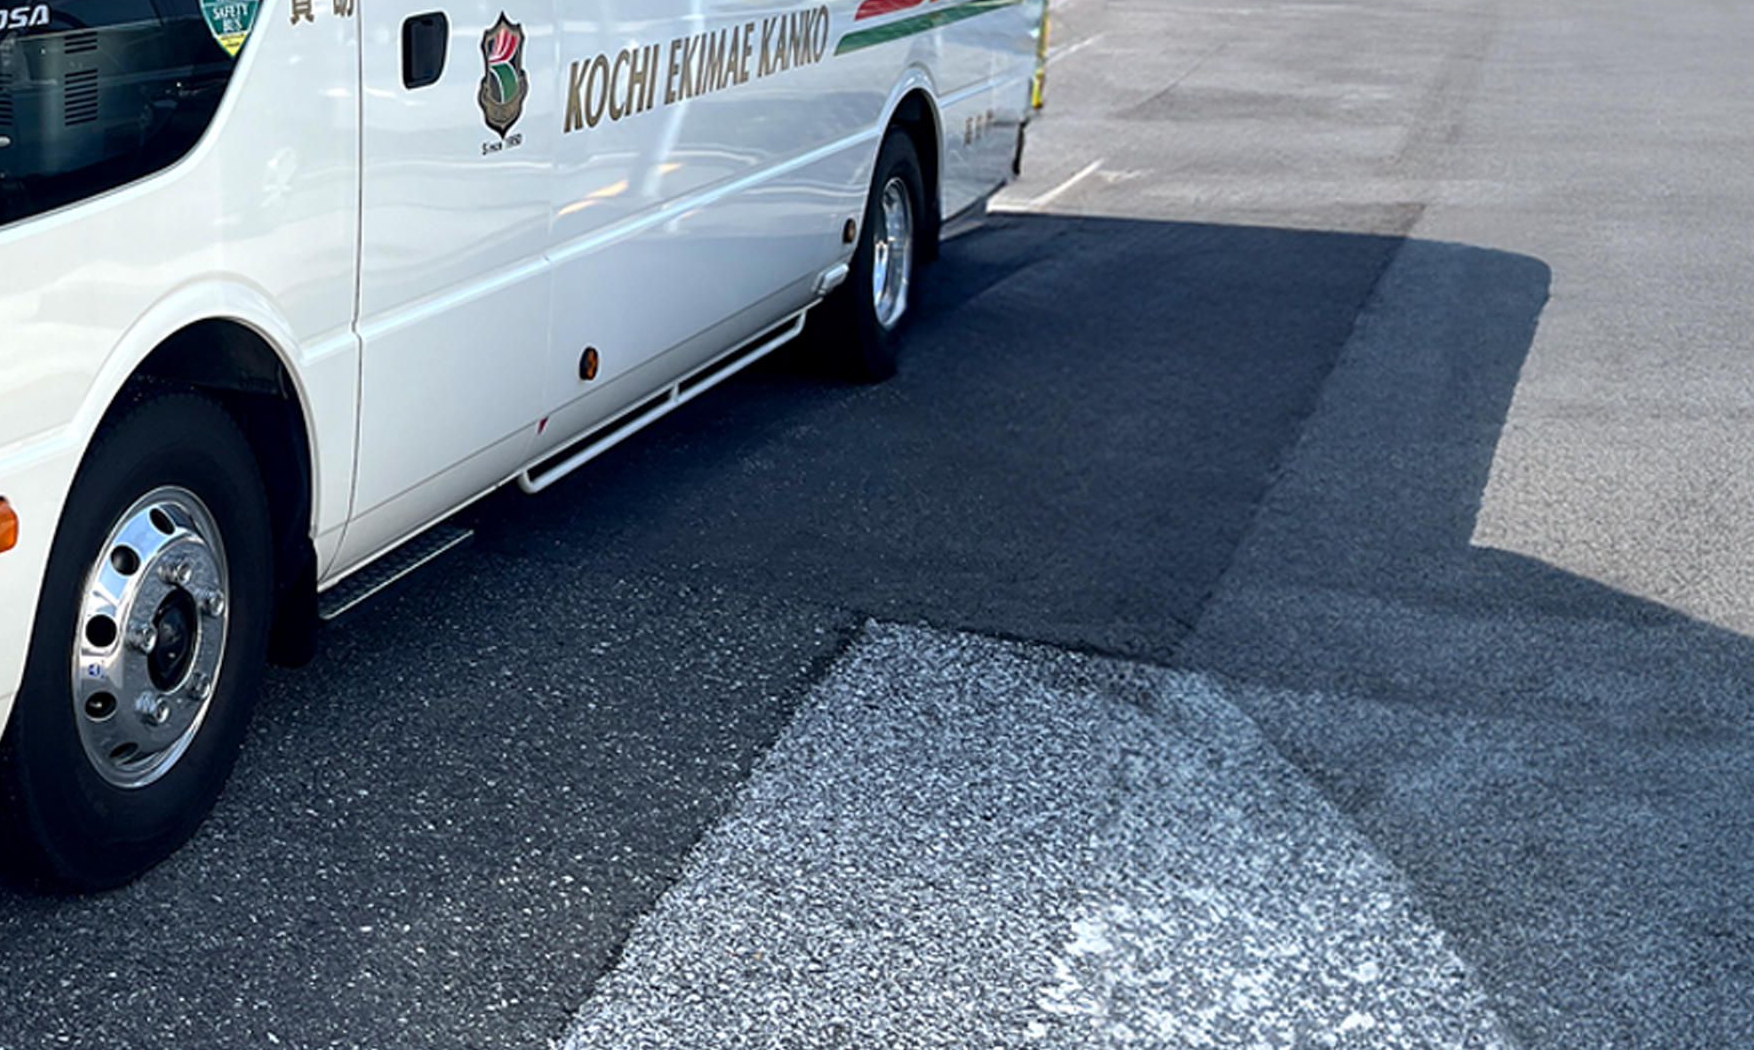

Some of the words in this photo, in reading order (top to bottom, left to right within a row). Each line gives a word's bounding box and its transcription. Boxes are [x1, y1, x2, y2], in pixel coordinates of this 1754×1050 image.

[563, 42, 661, 135] KOCHI
[664, 21, 756, 106] EKIMAE
[757, 4, 830, 78] KANKO
